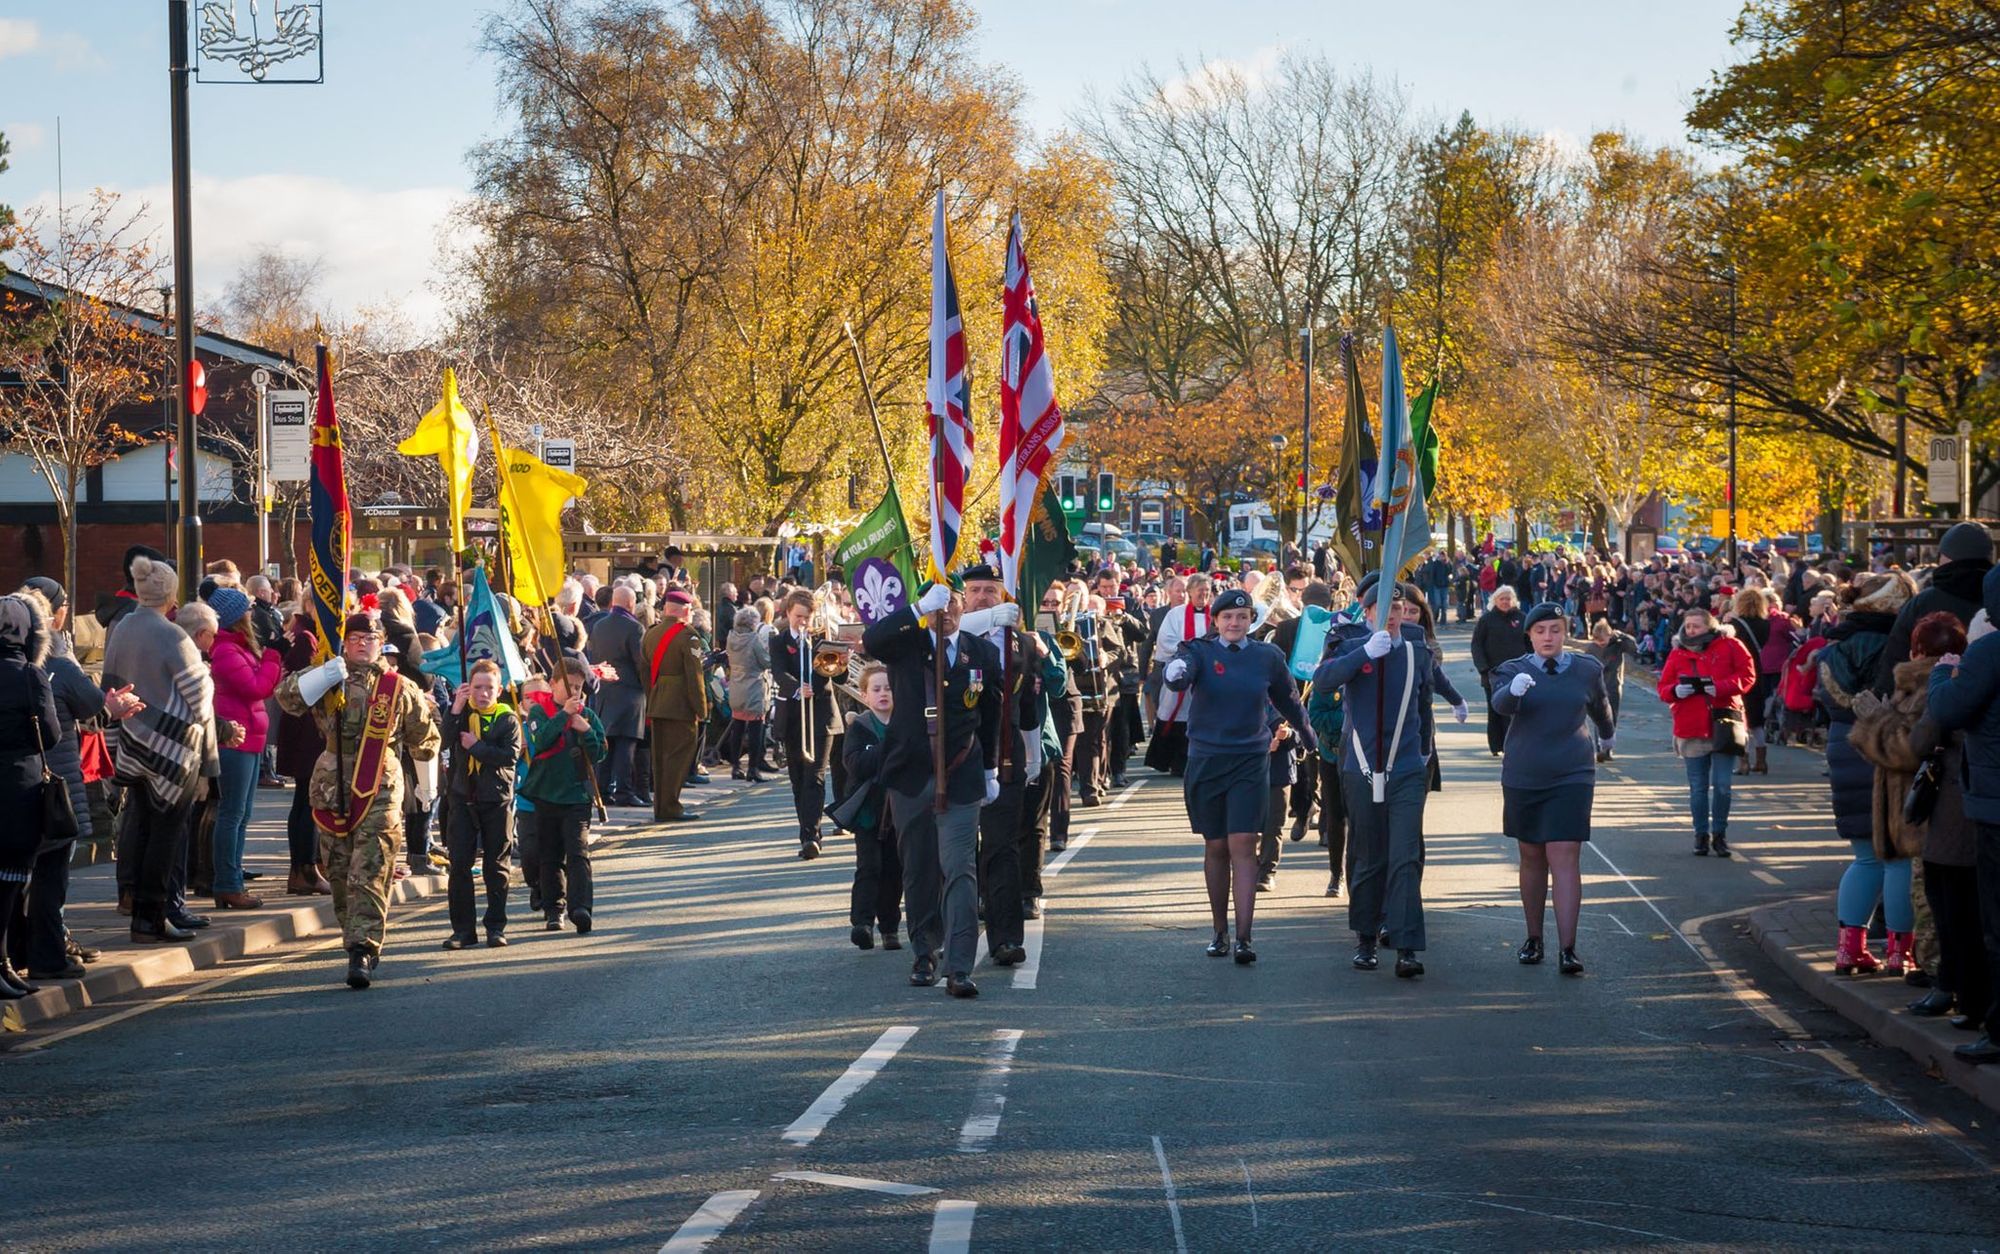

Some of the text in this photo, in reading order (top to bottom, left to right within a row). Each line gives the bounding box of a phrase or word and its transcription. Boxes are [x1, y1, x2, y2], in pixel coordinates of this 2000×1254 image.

[256, 371, 266, 384] D
[274, 415, 303, 424] Bus Stop
[534, 425, 540, 435] E
[547, 457, 570, 465] Bus Stop
